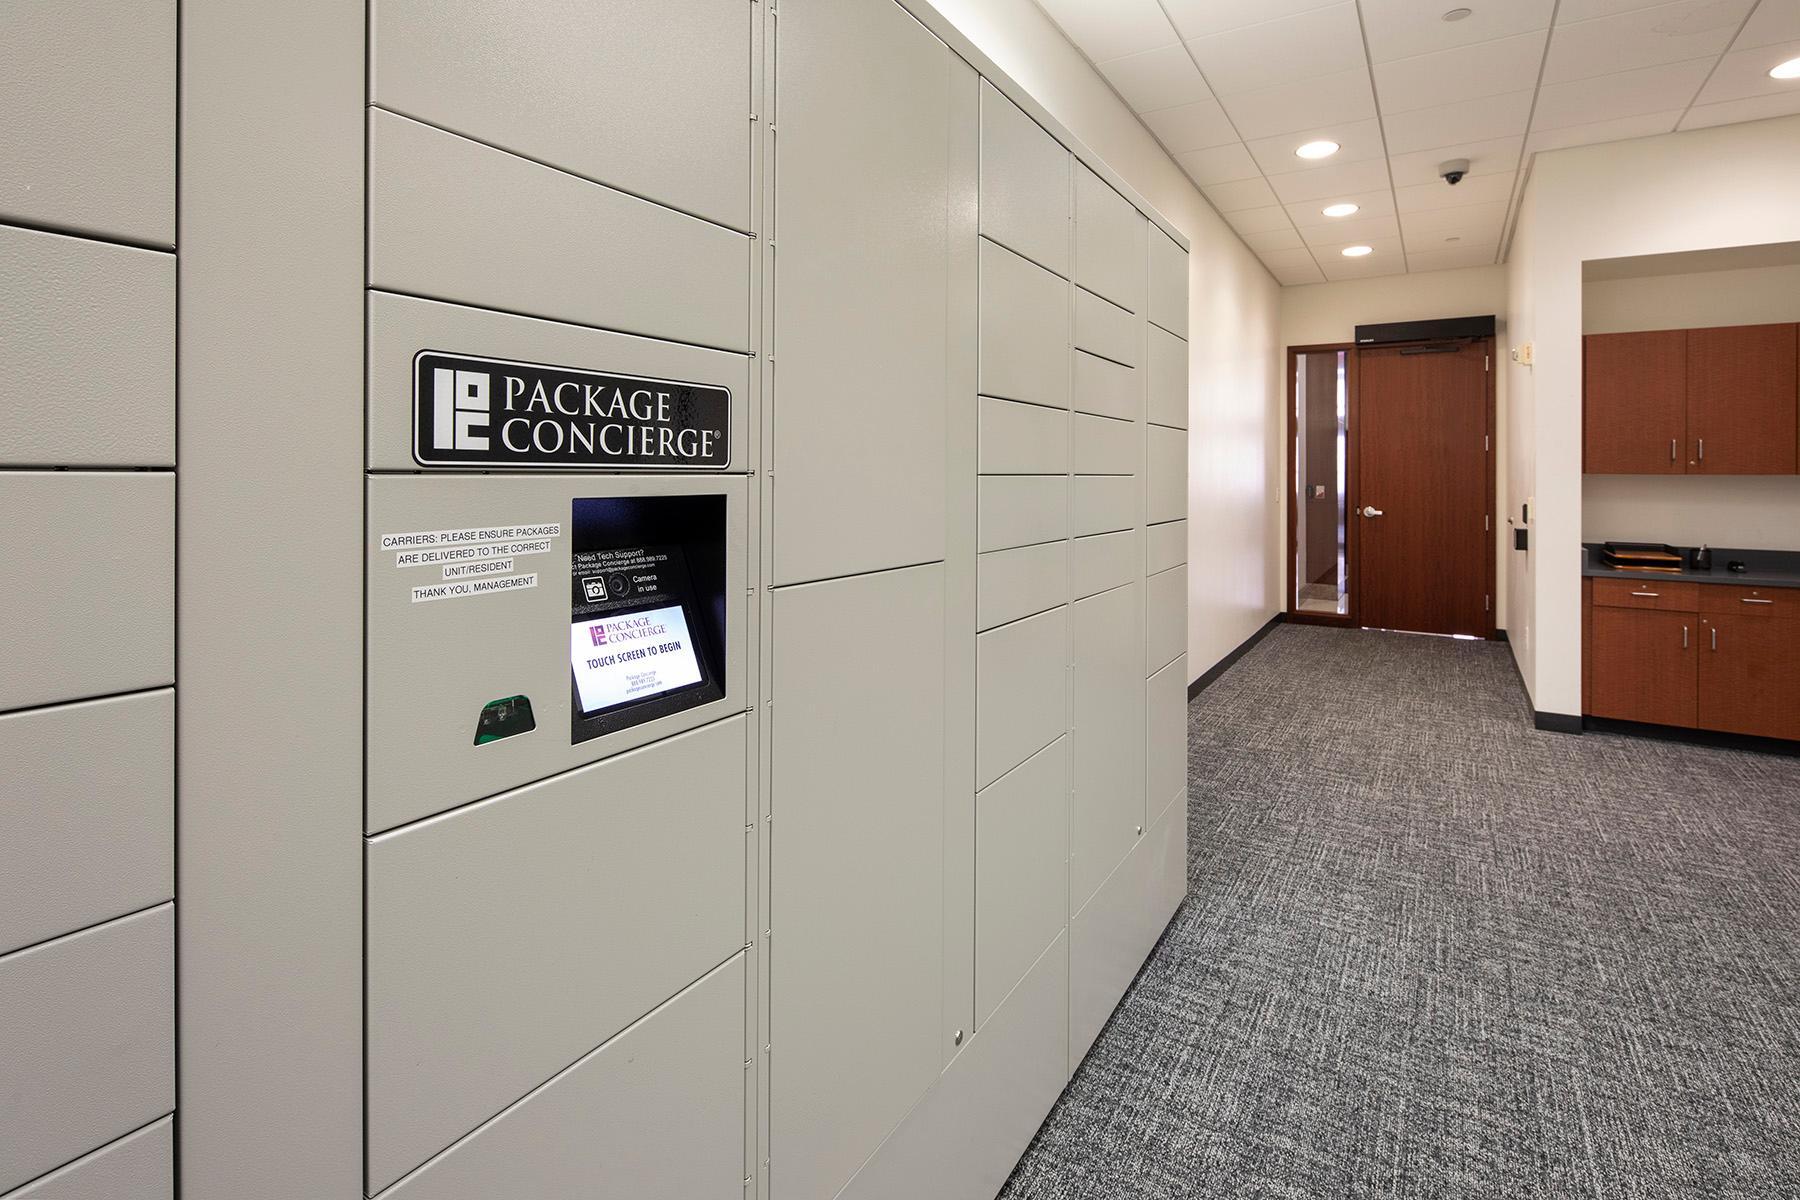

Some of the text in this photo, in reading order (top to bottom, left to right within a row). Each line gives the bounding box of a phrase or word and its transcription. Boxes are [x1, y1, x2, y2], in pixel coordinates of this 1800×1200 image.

[503, 376, 671, 422] PACKAGE
[382, 526, 560, 547] CARRIERS: PLEASE ENSURE PACKAGES
[398, 541, 550, 564] ARE DELIVERED TO THE CORRECT
[578, 549, 645, 562] Need Tech Support?
[444, 560, 512, 577] UNIT/RESIDENT
[633, 574, 658, 583] Camera
[414, 576, 534, 599] THANK YOU, MANAGEMENT
[606, 617, 651, 633] PACKAGE
[608, 624, 667, 644] CONCIERGE
[587, 641, 682, 670] TOUCH SCREEN TO BEGIN
